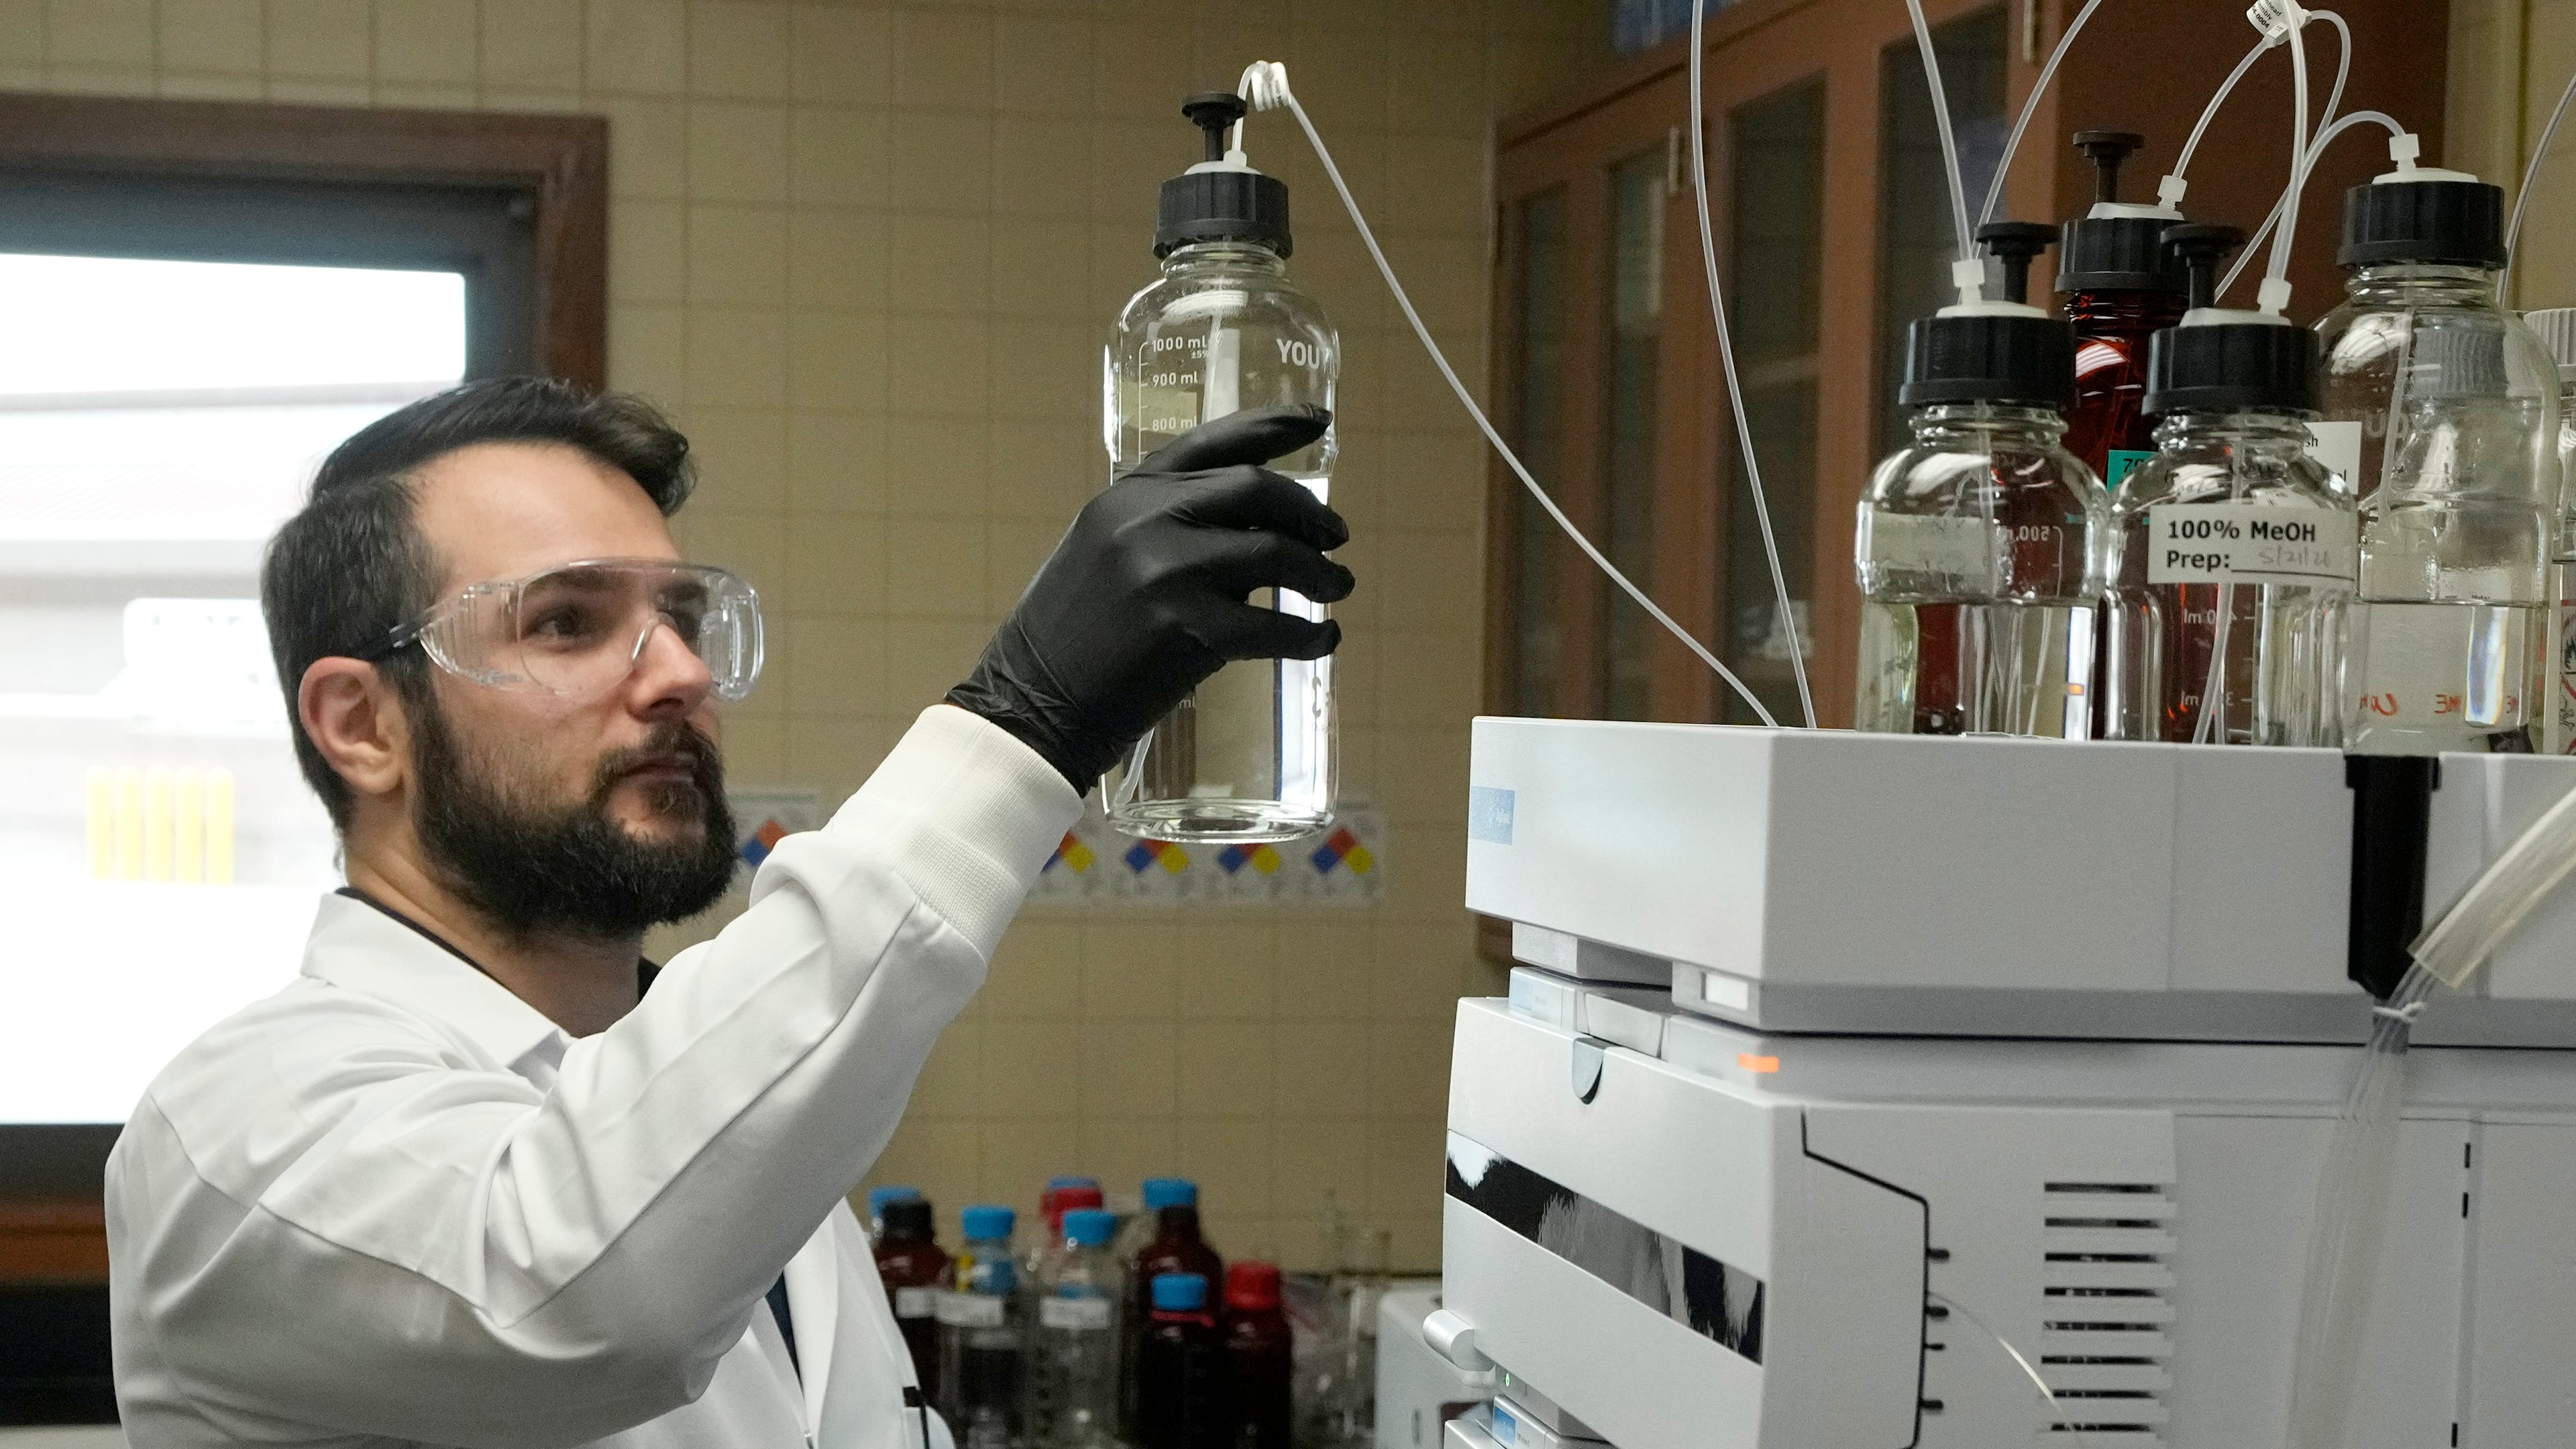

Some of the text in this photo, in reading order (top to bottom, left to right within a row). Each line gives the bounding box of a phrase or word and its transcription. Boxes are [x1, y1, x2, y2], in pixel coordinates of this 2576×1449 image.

[1152, 335, 1207, 352] 1000 ml
[1276, 338, 1320, 370] YOU
[1152, 370, 1198, 387] 900 ml
[1152, 415, 1197, 432] 800 ml
[2168, 520, 2316, 543] 100% MeOH
[2166, 550, 2230, 572] Prep:
